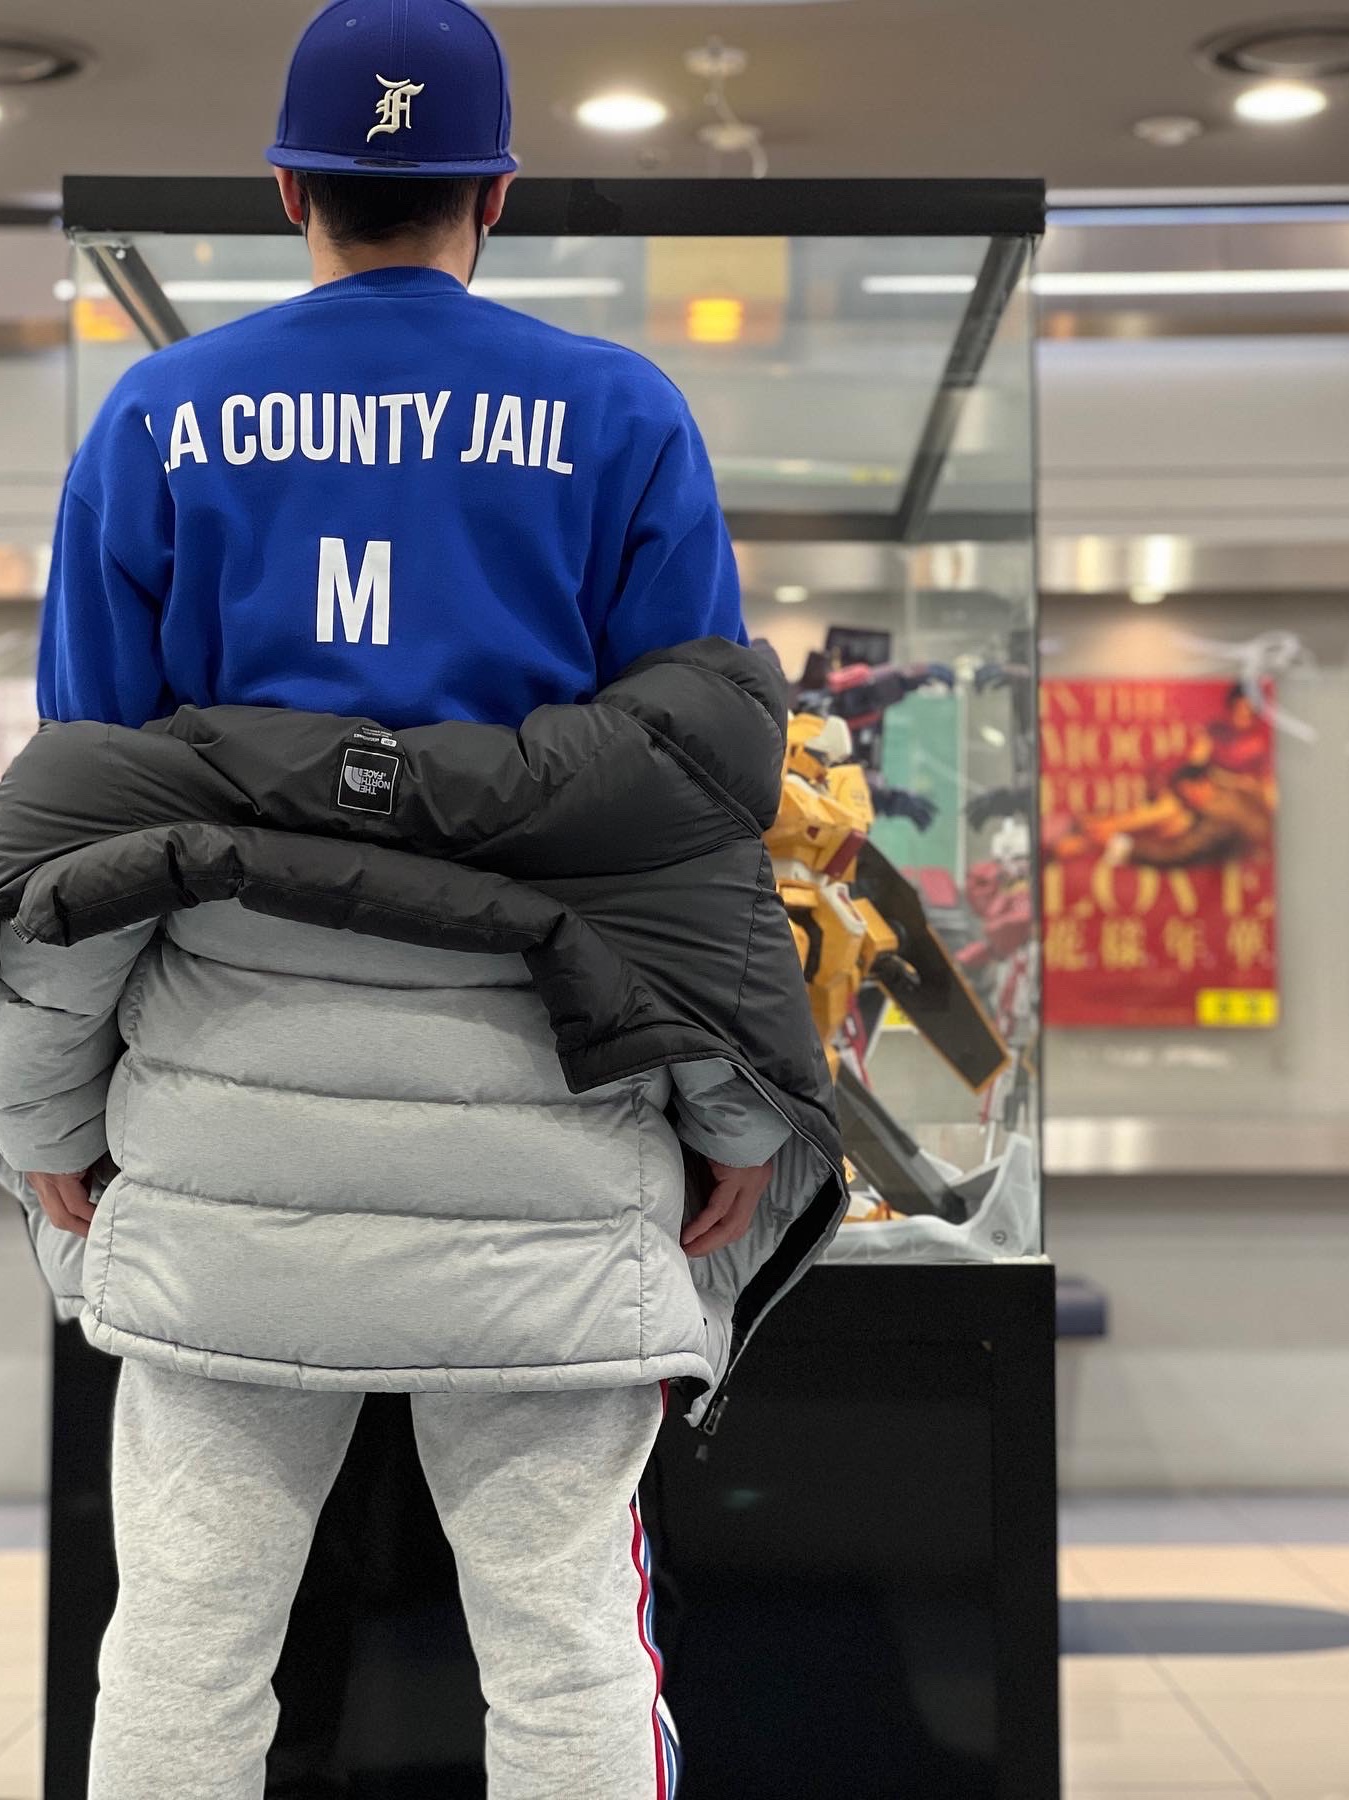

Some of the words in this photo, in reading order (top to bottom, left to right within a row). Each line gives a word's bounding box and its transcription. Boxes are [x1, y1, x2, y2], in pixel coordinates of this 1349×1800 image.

[144, 400, 209, 475] A
[221, 390, 452, 466] COUNTY
[460, 392, 574, 475] JAIL
[316, 536, 392, 646] M
[362, 769, 384, 780] FACE
[359, 784, 377, 796] THE
[361, 777, 391, 791] NORTH
